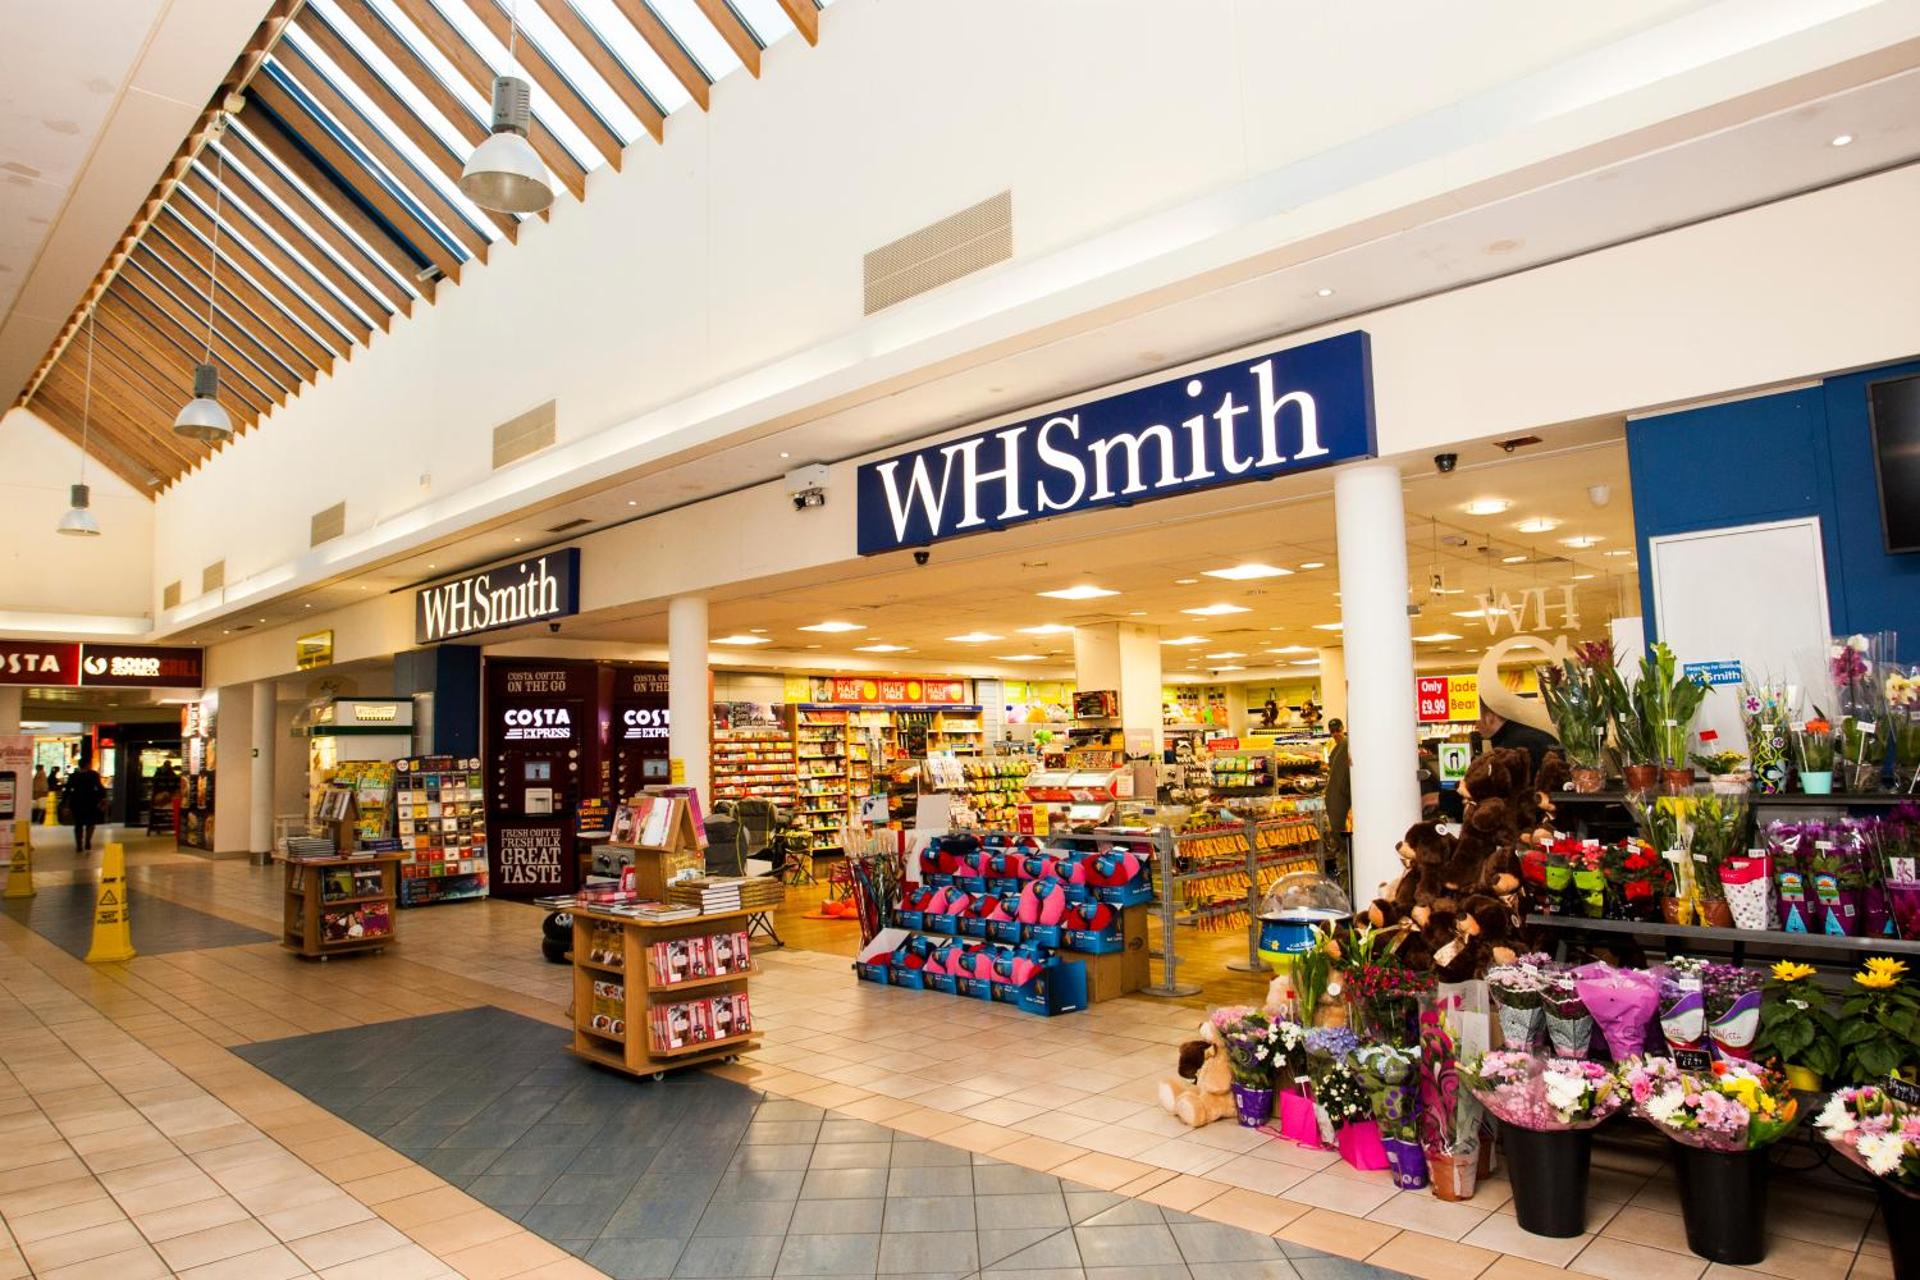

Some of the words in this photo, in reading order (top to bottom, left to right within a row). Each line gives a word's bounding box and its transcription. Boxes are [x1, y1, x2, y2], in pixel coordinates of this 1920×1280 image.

[875, 358, 1330, 544] WHSmith
[422, 557, 560, 640] WHSmith
[1473, 584, 1582, 636] WH
[507, 672, 533, 681] COSTA
[535, 671, 566, 680] COFFEE
[507, 681, 522, 692] ON
[525, 681, 548, 692] THE
[550, 680, 566, 691] GO
[633, 682, 647, 692] ON
[1421, 681, 1443, 694] Only
[1450, 681, 1477, 693] Jade
[1421, 699, 1446, 715] £9.99
[1450, 700, 1476, 710] Bear
[504, 708, 571, 727] COSTA
[623, 709, 670, 727] COST
[523, 728, 571, 739] EXPRESS
[642, 728, 670, 738] EXPR
[501, 828, 528, 838] FRESH
[529, 828, 561, 838] COFFEE
[501, 837, 535, 848] FRESH
[535, 837, 560, 847] MILK
[500, 847, 561, 865] GREAT
[500, 864, 561, 884] TASTE
